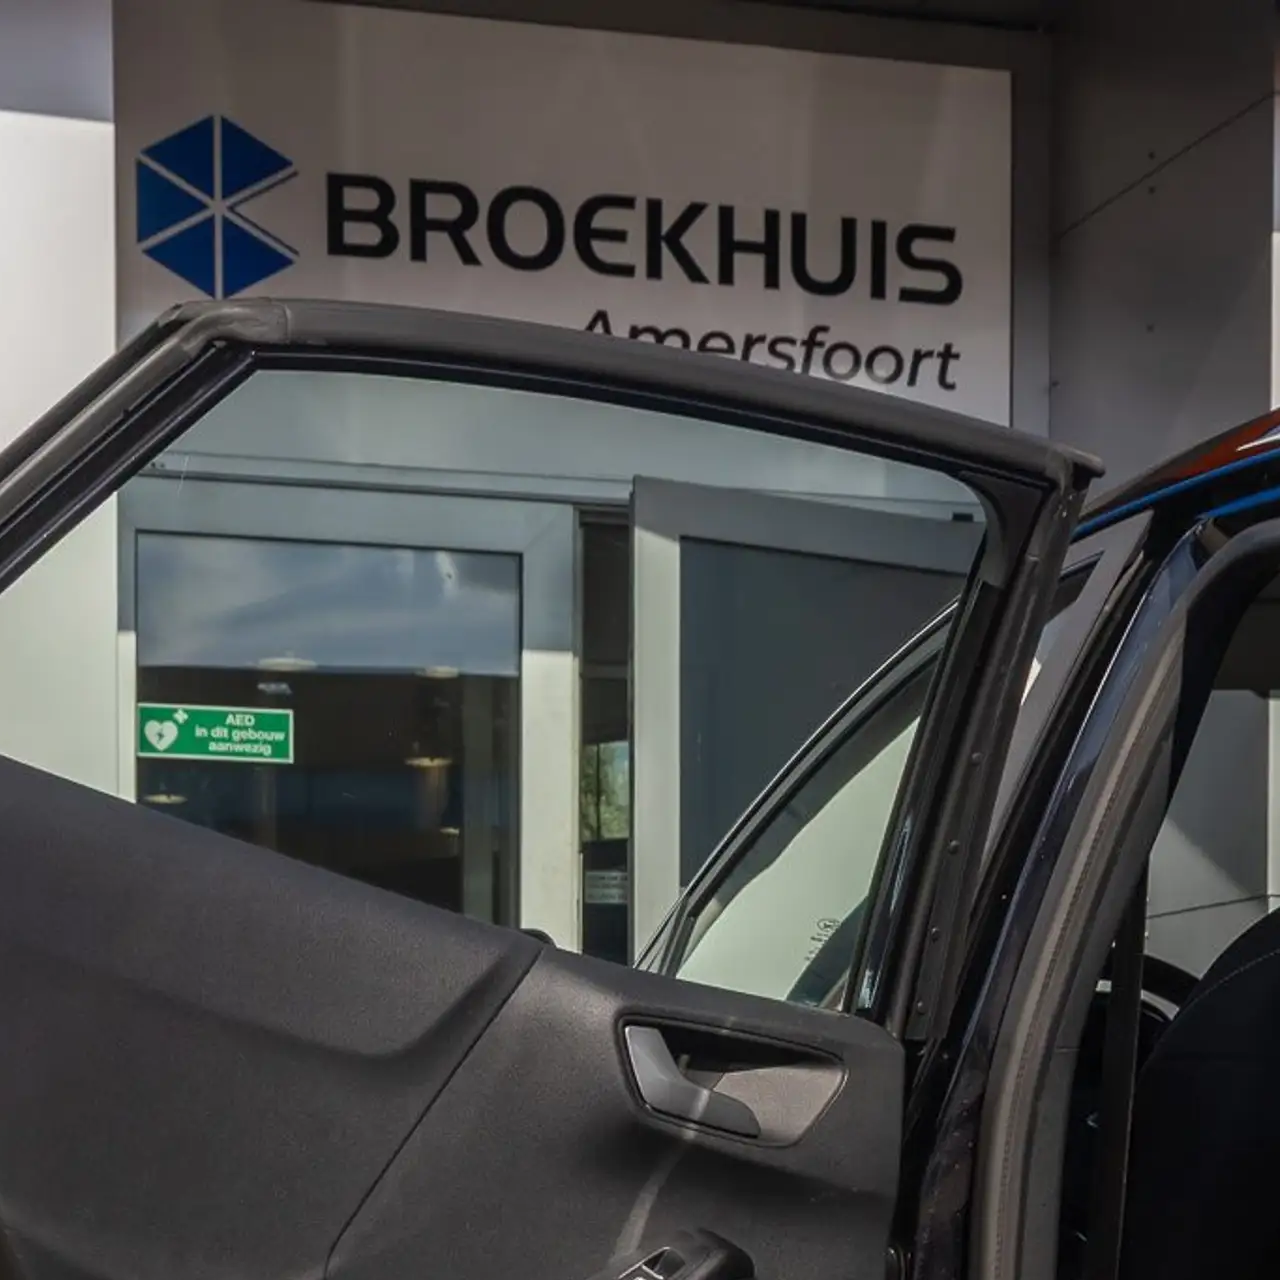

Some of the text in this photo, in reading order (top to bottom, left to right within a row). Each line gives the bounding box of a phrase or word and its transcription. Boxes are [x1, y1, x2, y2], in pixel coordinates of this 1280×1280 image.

[325, 172, 963, 306] BROEKHUIS
[225, 713, 255, 727] AED
[210, 725, 228, 739] dit
[231, 728, 286, 742] gebouw
[208, 741, 272, 756] aanwezig
